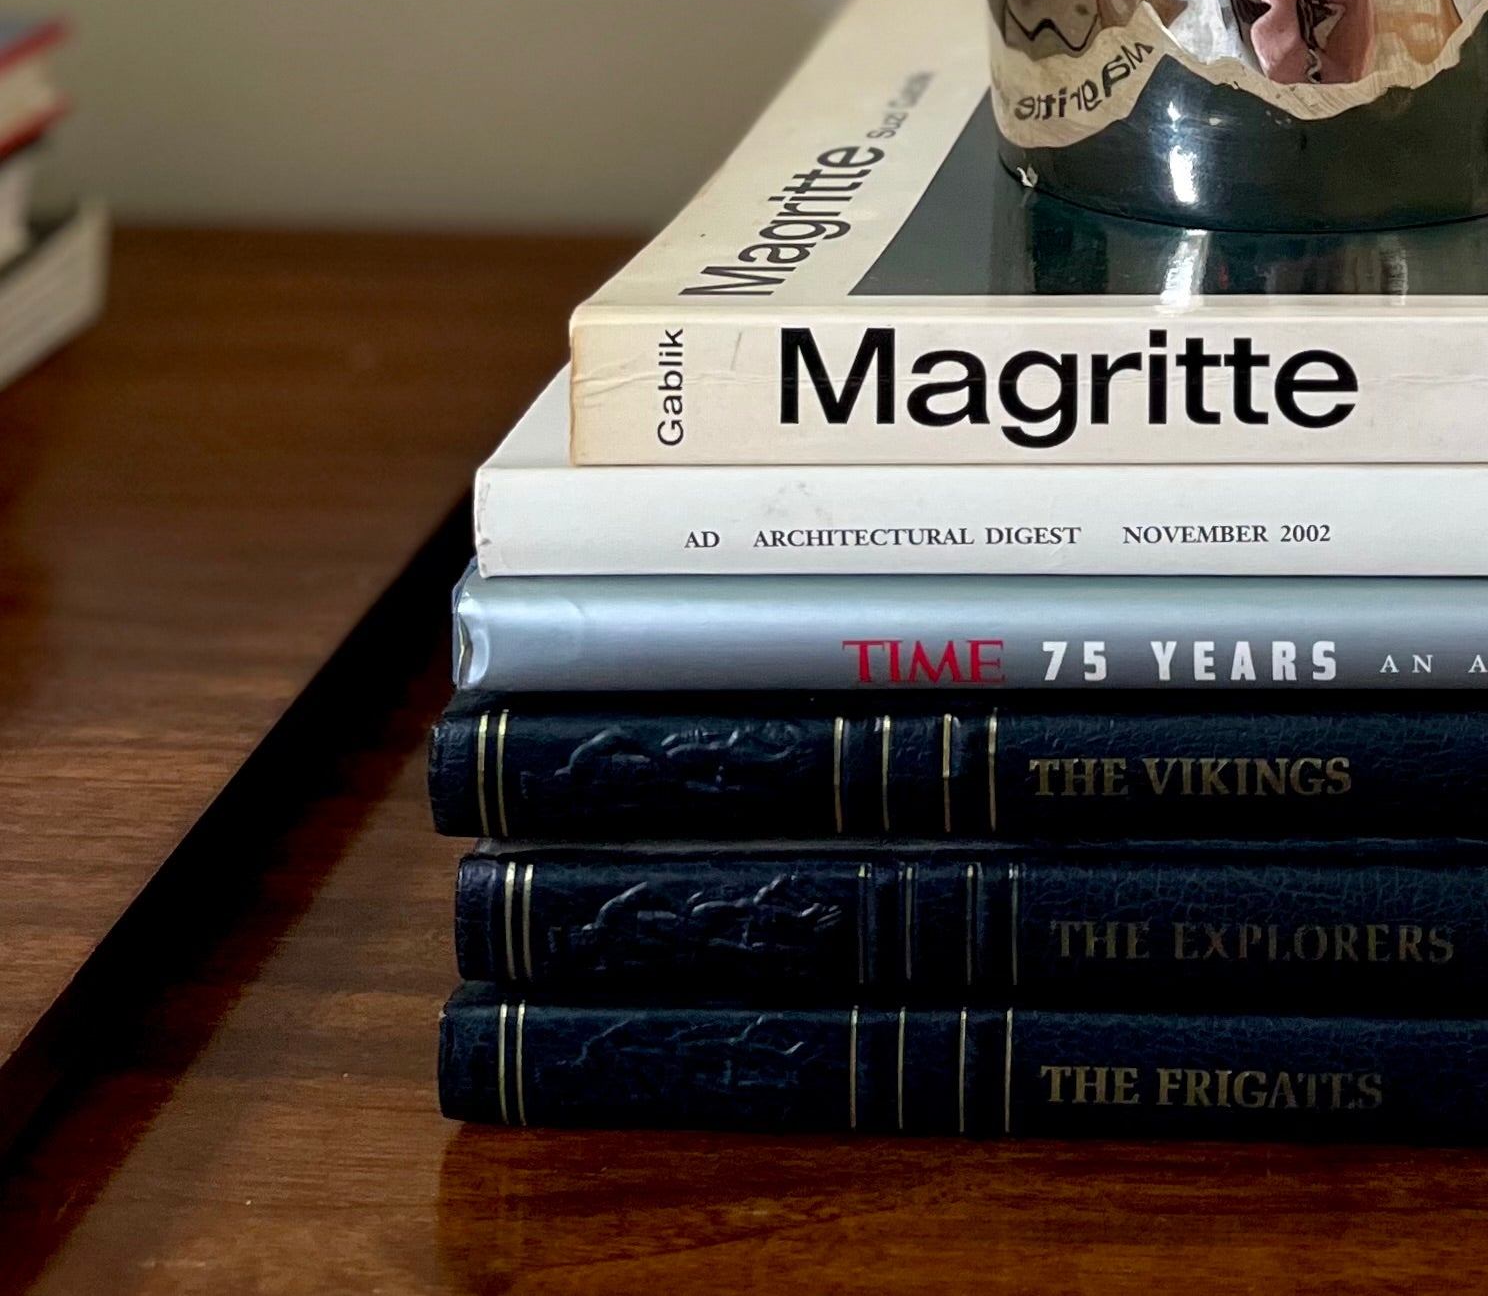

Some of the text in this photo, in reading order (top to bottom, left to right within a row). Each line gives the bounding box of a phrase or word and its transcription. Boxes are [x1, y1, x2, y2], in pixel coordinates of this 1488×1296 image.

[677, 145, 886, 296] Magritte
[657, 327, 684, 446] Gablik
[779, 327, 1359, 449] Magritte
[684, 524, 1332, 549] AD ARCHITECTURAL DIGEST NOVEMBER 2002
[842, 639, 1006, 684] TIME
[1042, 641, 1108, 681] 75
[1150, 640, 1338, 681] YEARS
[1378, 654, 1434, 674] AN
[1028, 756, 1351, 797] THE VIKINGS
[1051, 921, 1456, 964] THE EXPLORERS
[1040, 1065, 1139, 1105] THE
